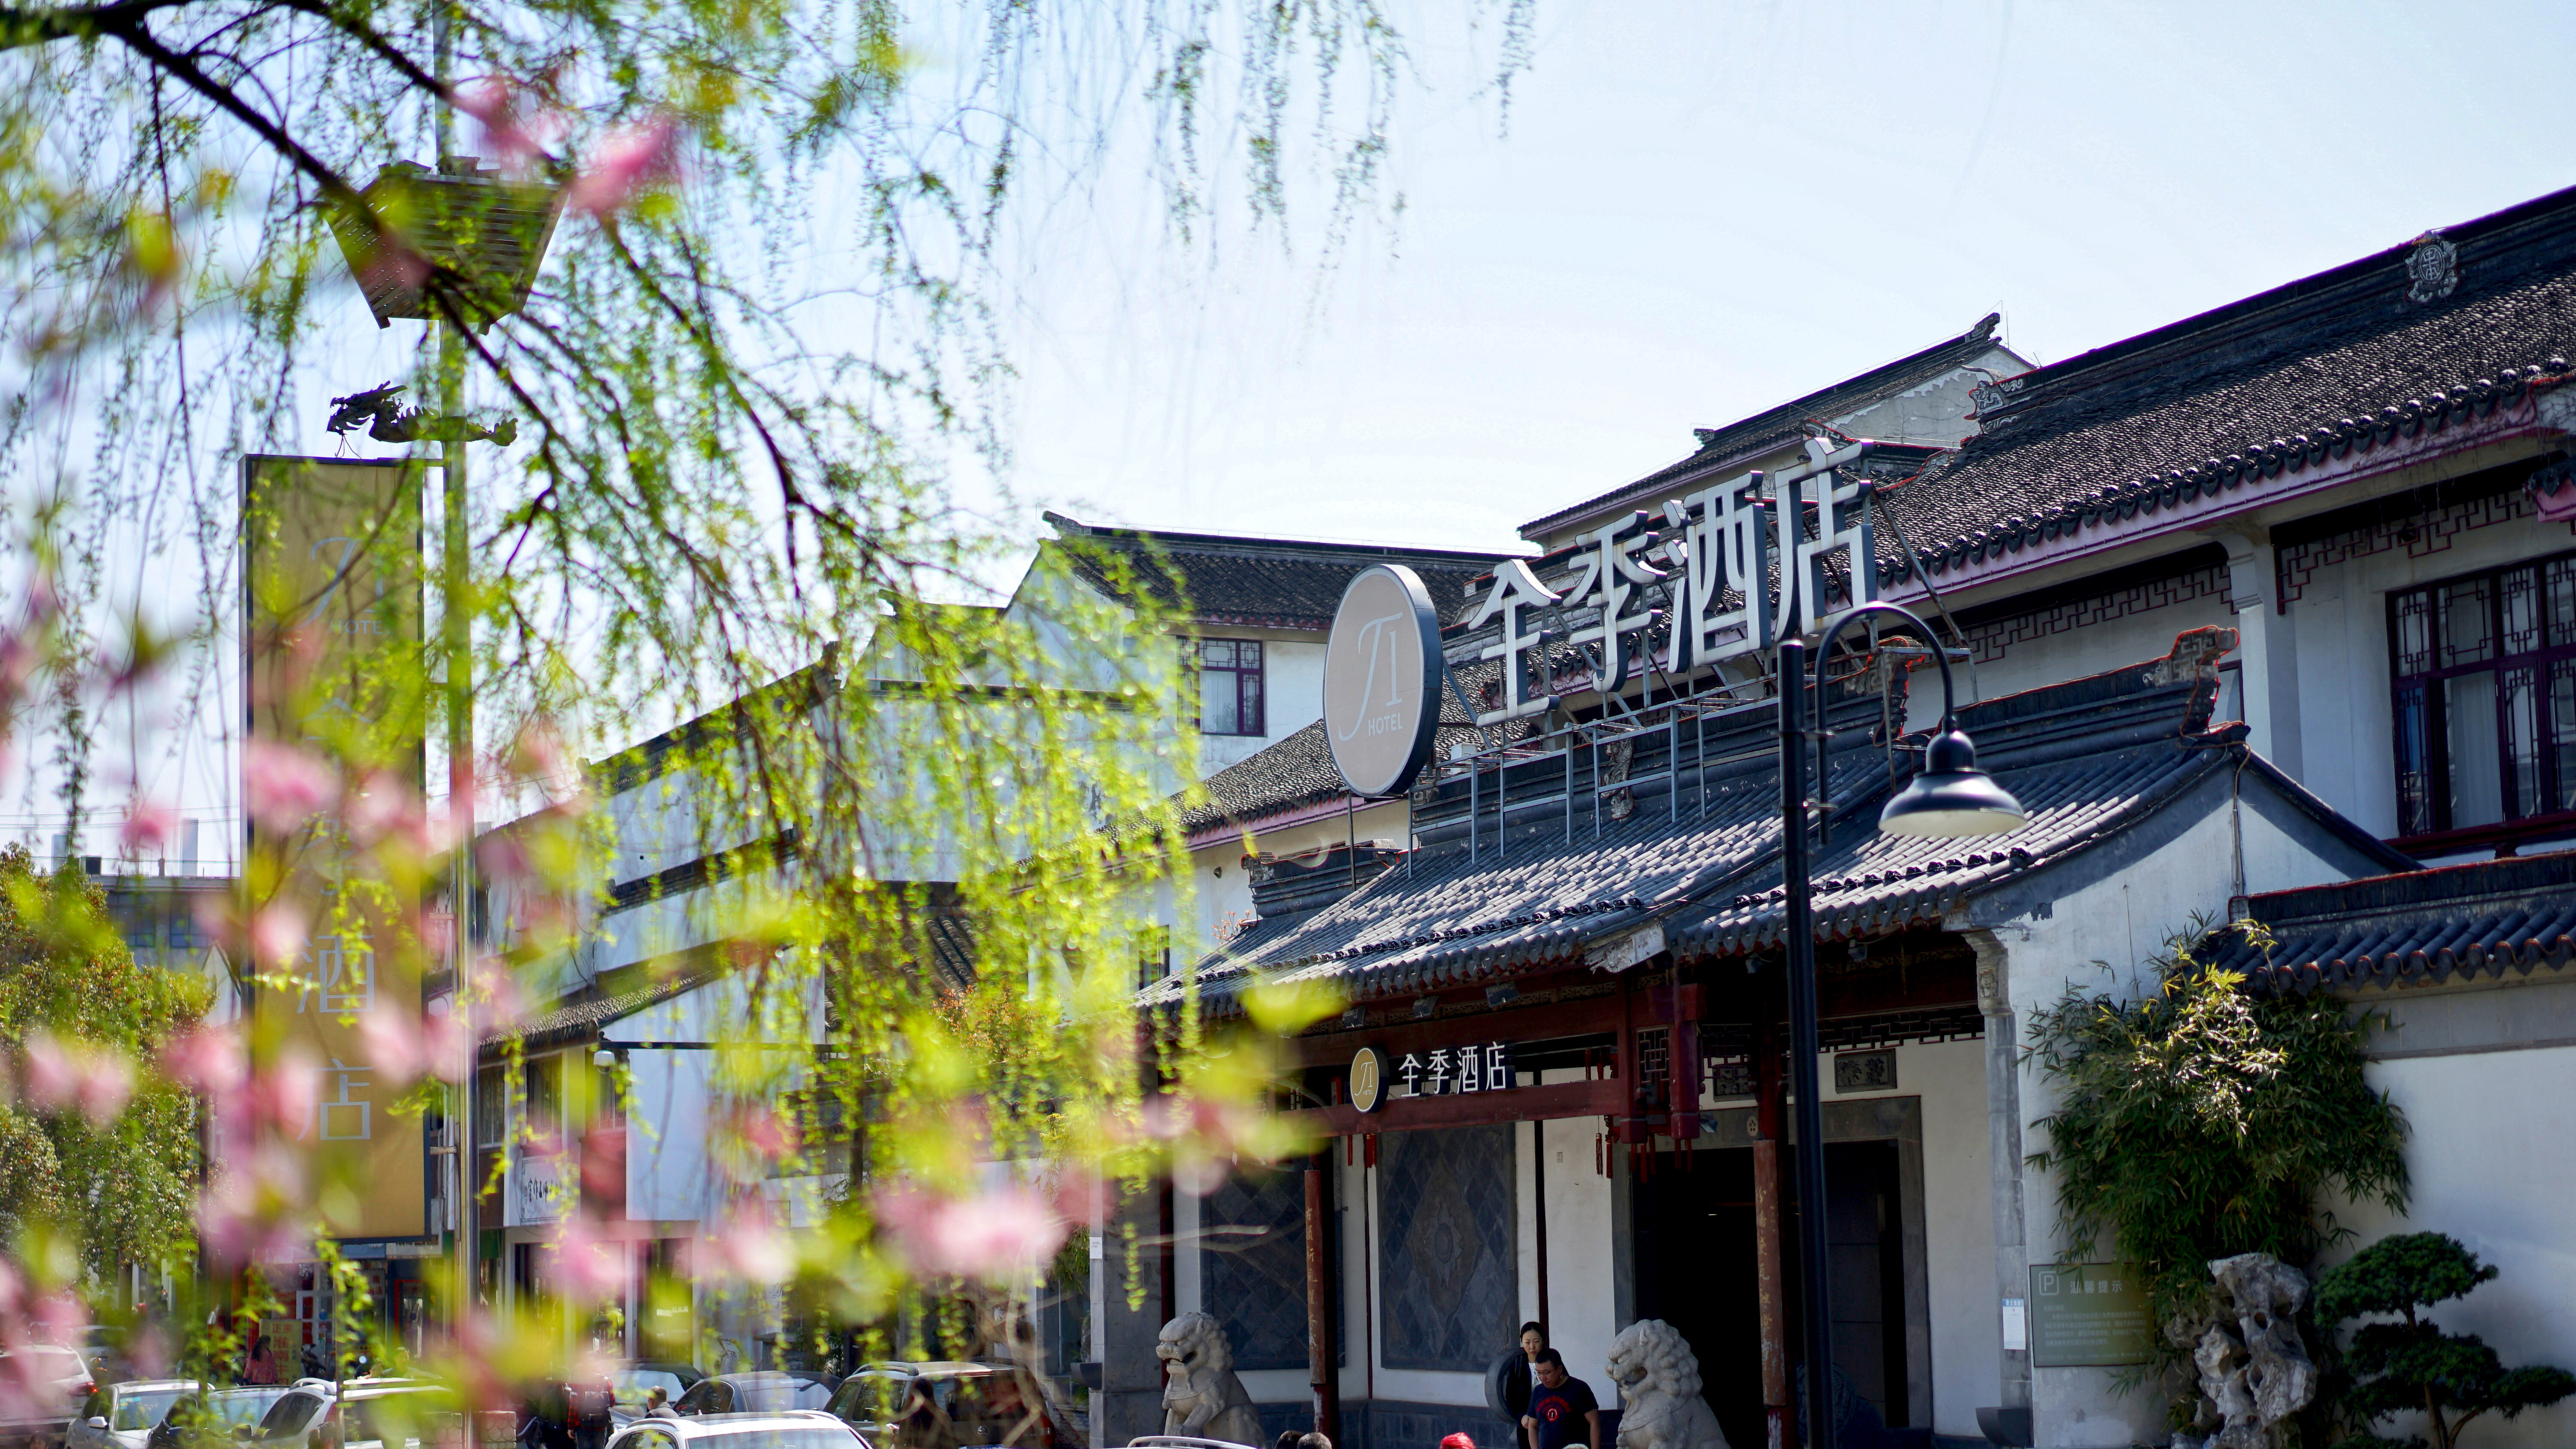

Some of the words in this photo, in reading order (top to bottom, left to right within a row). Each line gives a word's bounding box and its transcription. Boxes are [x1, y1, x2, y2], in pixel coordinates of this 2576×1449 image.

[1468, 437, 1874, 728] 全季酒店
[1368, 713, 1403, 736] HOTEL
[1398, 1041, 1506, 1098] 全季酒店
[2044, 1275, 2054, 1291] P
